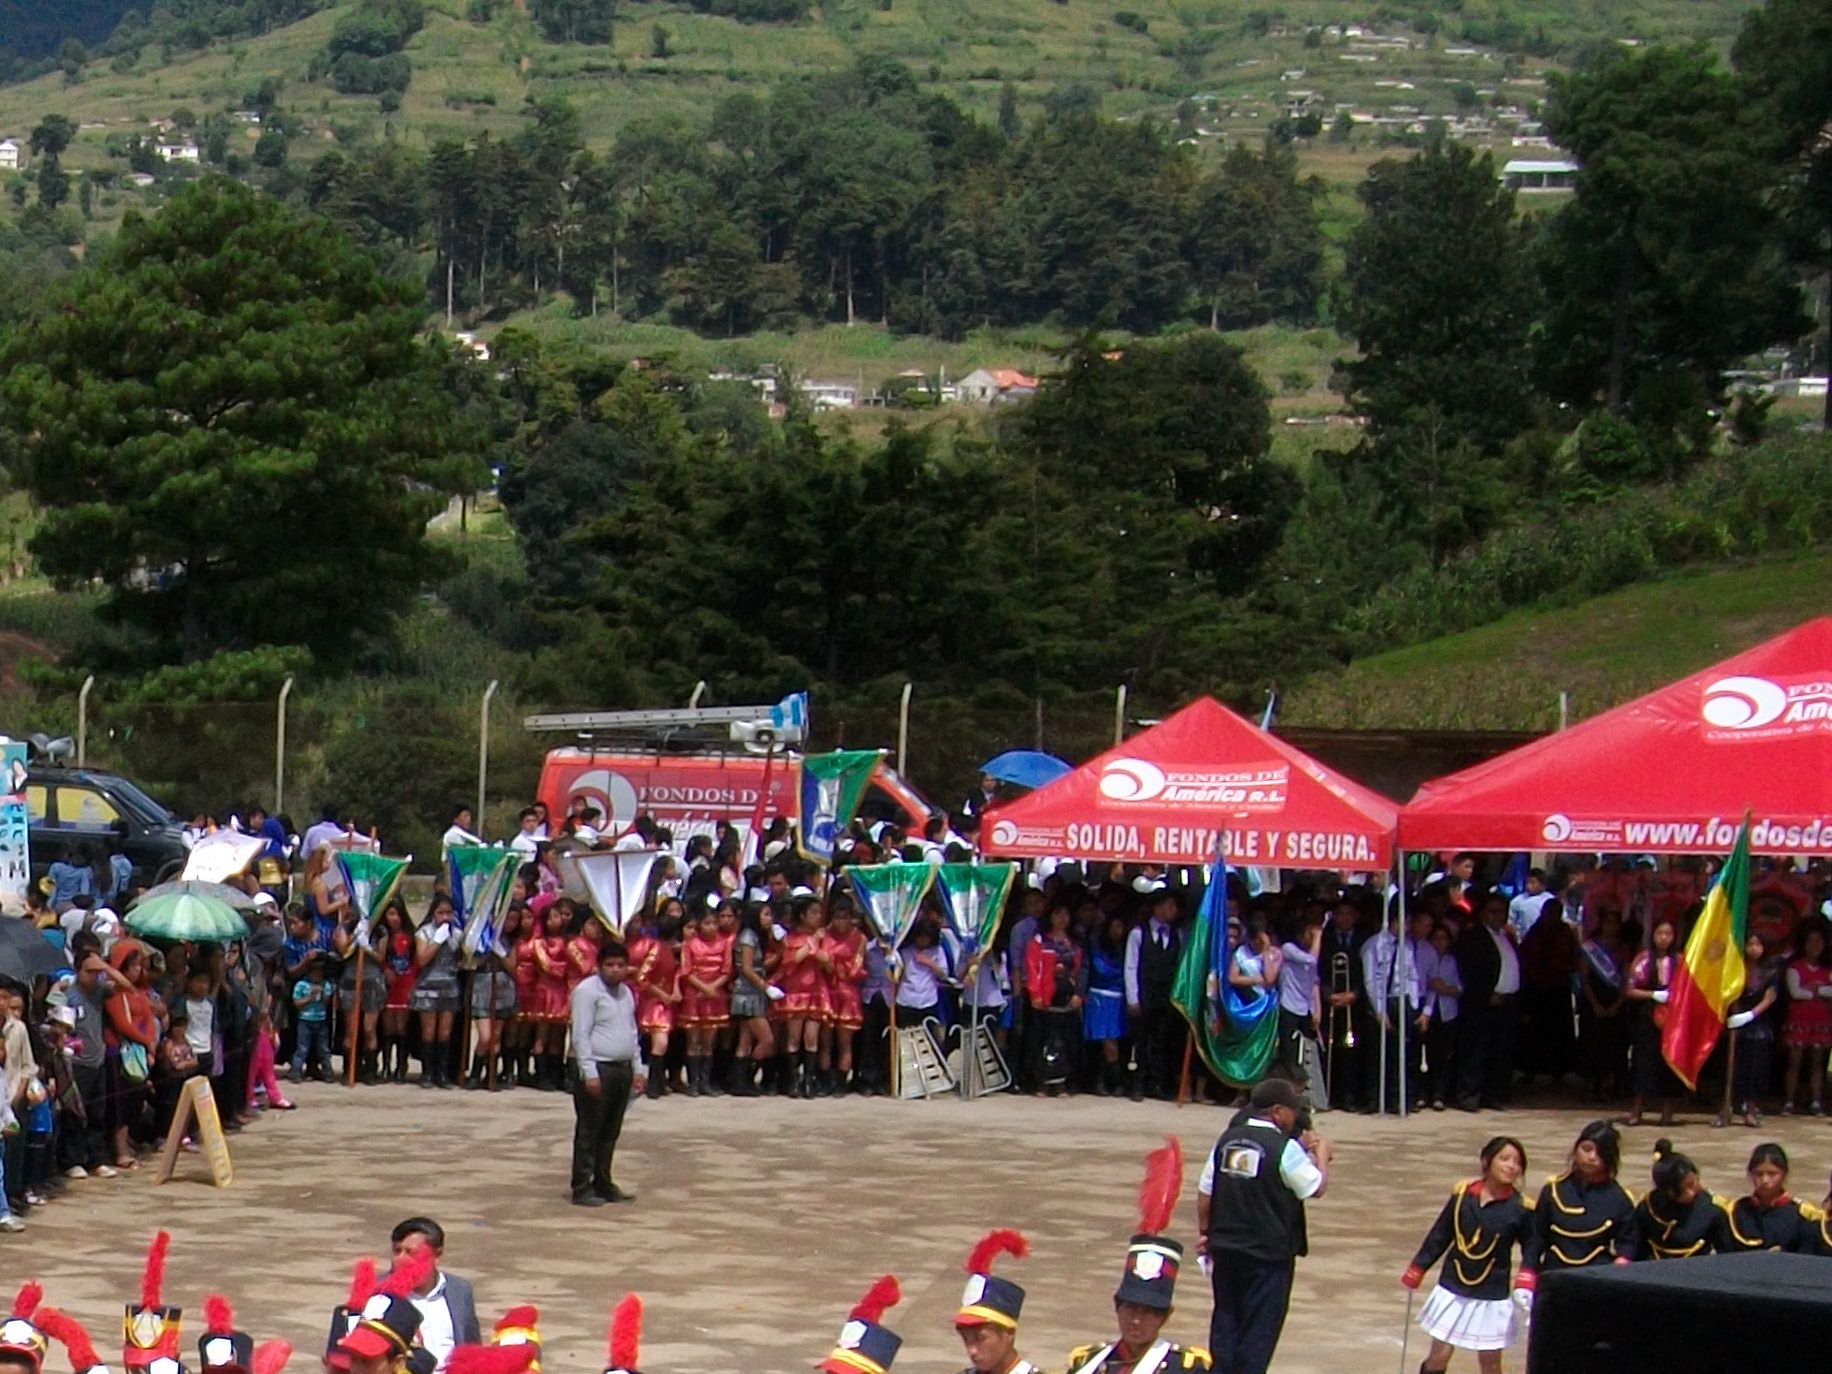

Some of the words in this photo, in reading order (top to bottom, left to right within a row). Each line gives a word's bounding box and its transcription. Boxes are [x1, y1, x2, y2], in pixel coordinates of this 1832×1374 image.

[1168, 772, 1252, 783] FONDOS
[1162, 785, 1247, 802] América
[1067, 824, 1146, 857] SOLIDA,
[1153, 827, 1258, 858] RENTABLE
[1267, 830, 1281, 857] Y
[1286, 831, 1376, 862] SEGURA.
